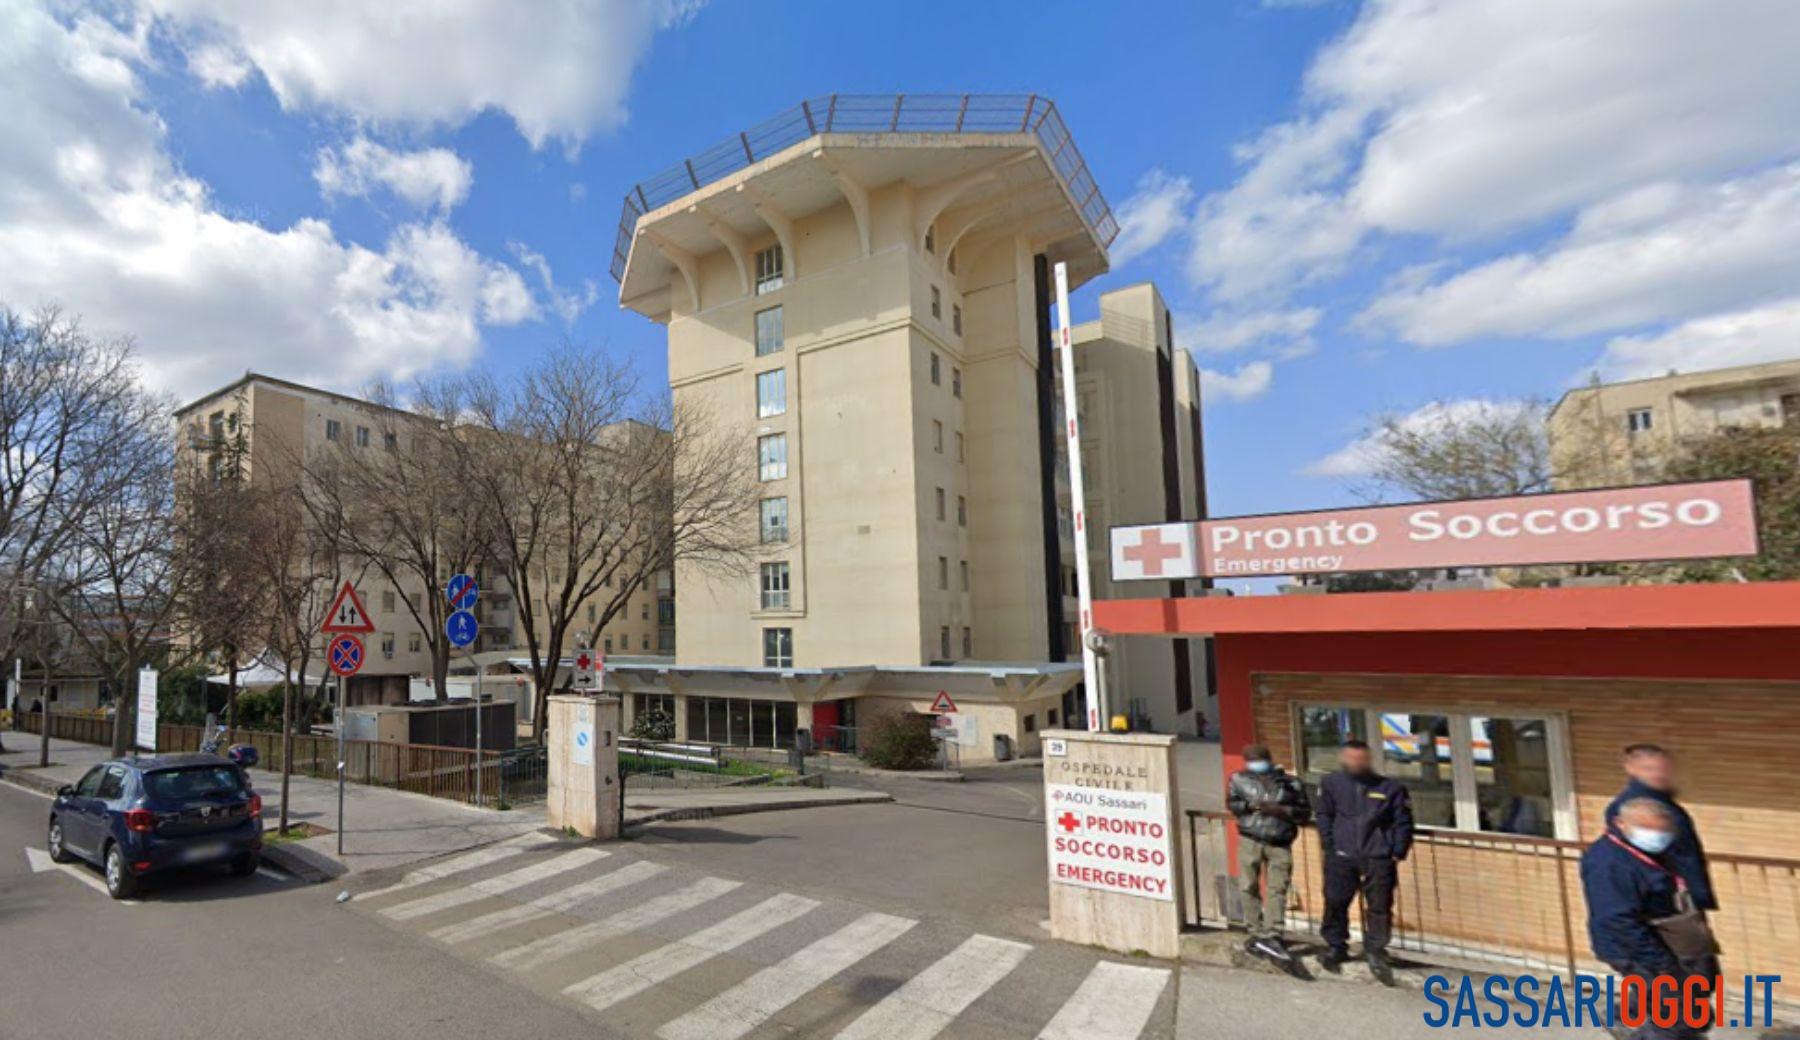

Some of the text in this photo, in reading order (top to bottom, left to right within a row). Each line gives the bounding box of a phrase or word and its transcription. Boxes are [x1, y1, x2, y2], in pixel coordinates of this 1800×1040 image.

[1211, 498, 1721, 553] Pronto Soccorso
[1213, 554, 1343, 574] Emergency
[1061, 761, 1148, 778] OSPEDALE
[1074, 777, 1134, 791] CIVILE
[1065, 791, 1148, 811] AOU Sassari
[1086, 815, 1164, 839] PRONTO
[1054, 837, 1166, 866] SOCCORSO
[1056, 863, 1168, 894] EMERGENCY
